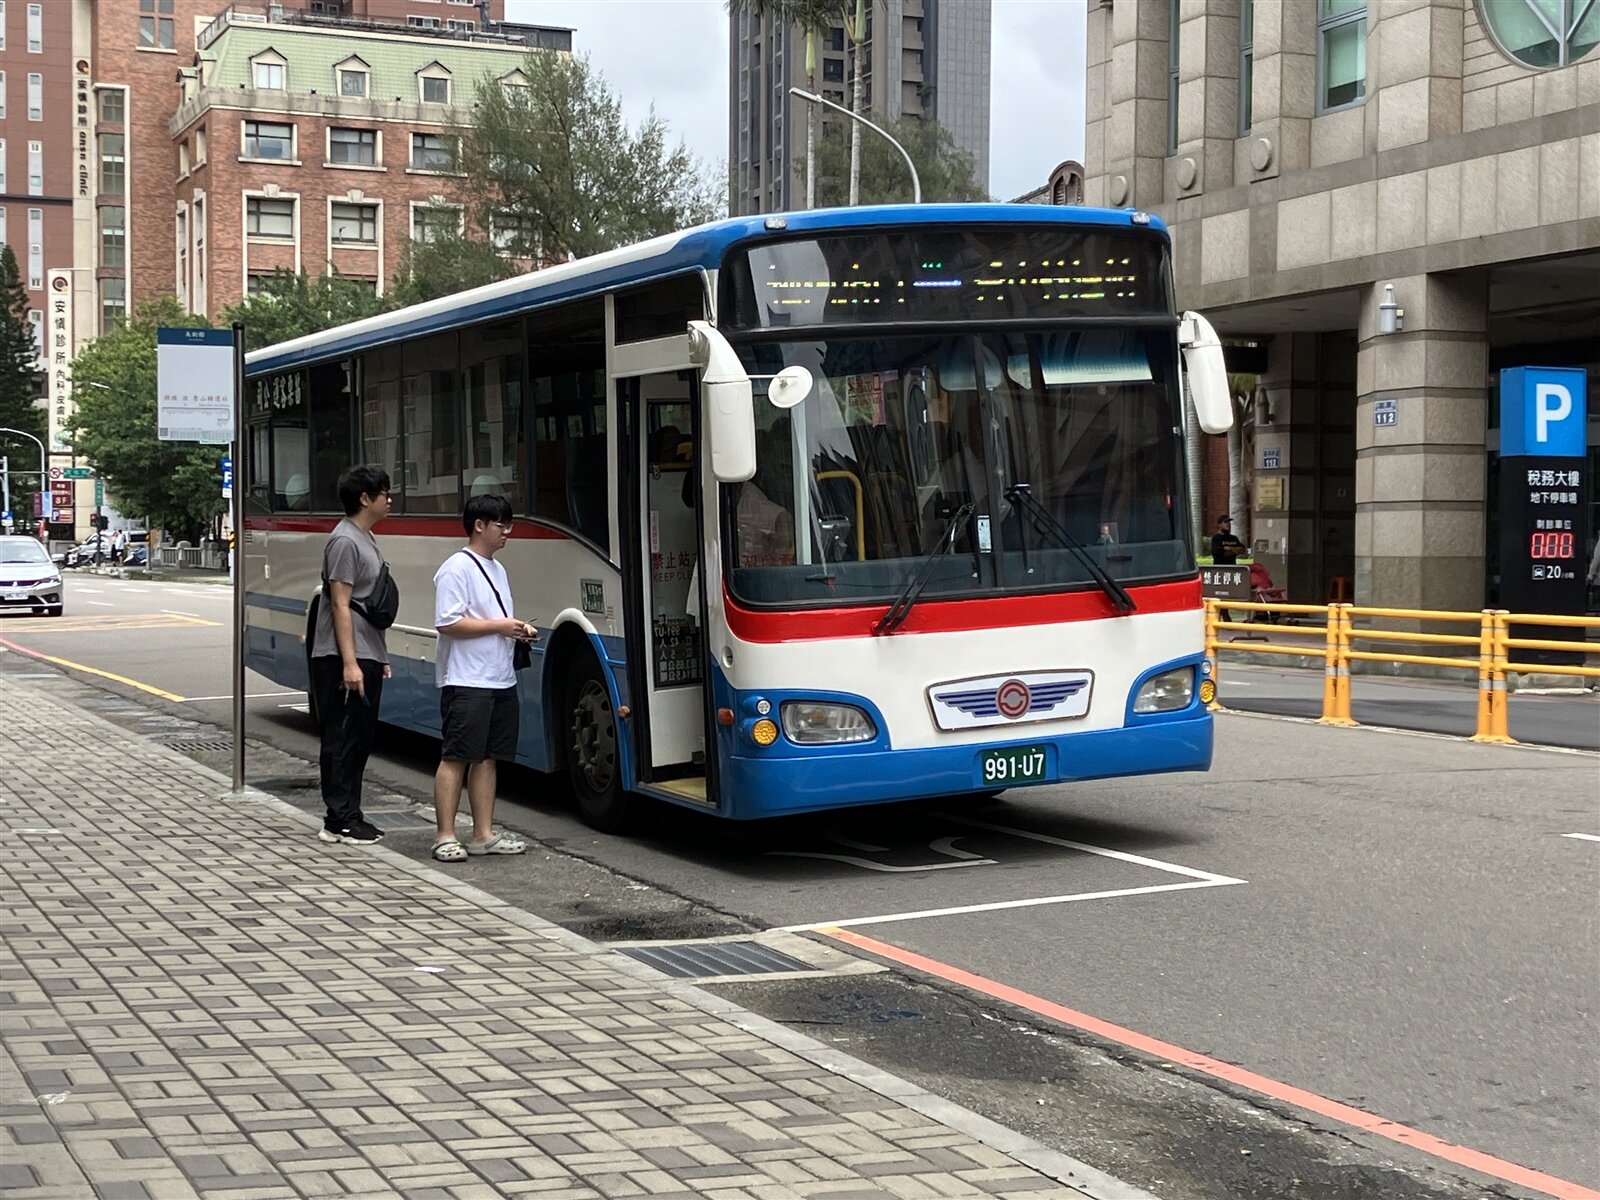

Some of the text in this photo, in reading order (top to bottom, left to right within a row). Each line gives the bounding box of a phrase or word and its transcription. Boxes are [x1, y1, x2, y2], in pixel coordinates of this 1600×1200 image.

[79, 164, 88, 196] clinic
[1377, 412, 1394, 424] 112
[1536, 383, 1572, 443] P
[1527, 470, 1580, 487] 稅務大樓
[1530, 492, 1577, 504] 地下停車場
[1531, 533, 1573, 558] 000
[1203, 572, 1242, 586] 禁止停車
[985, 753, 1044, 780] 991-U7
